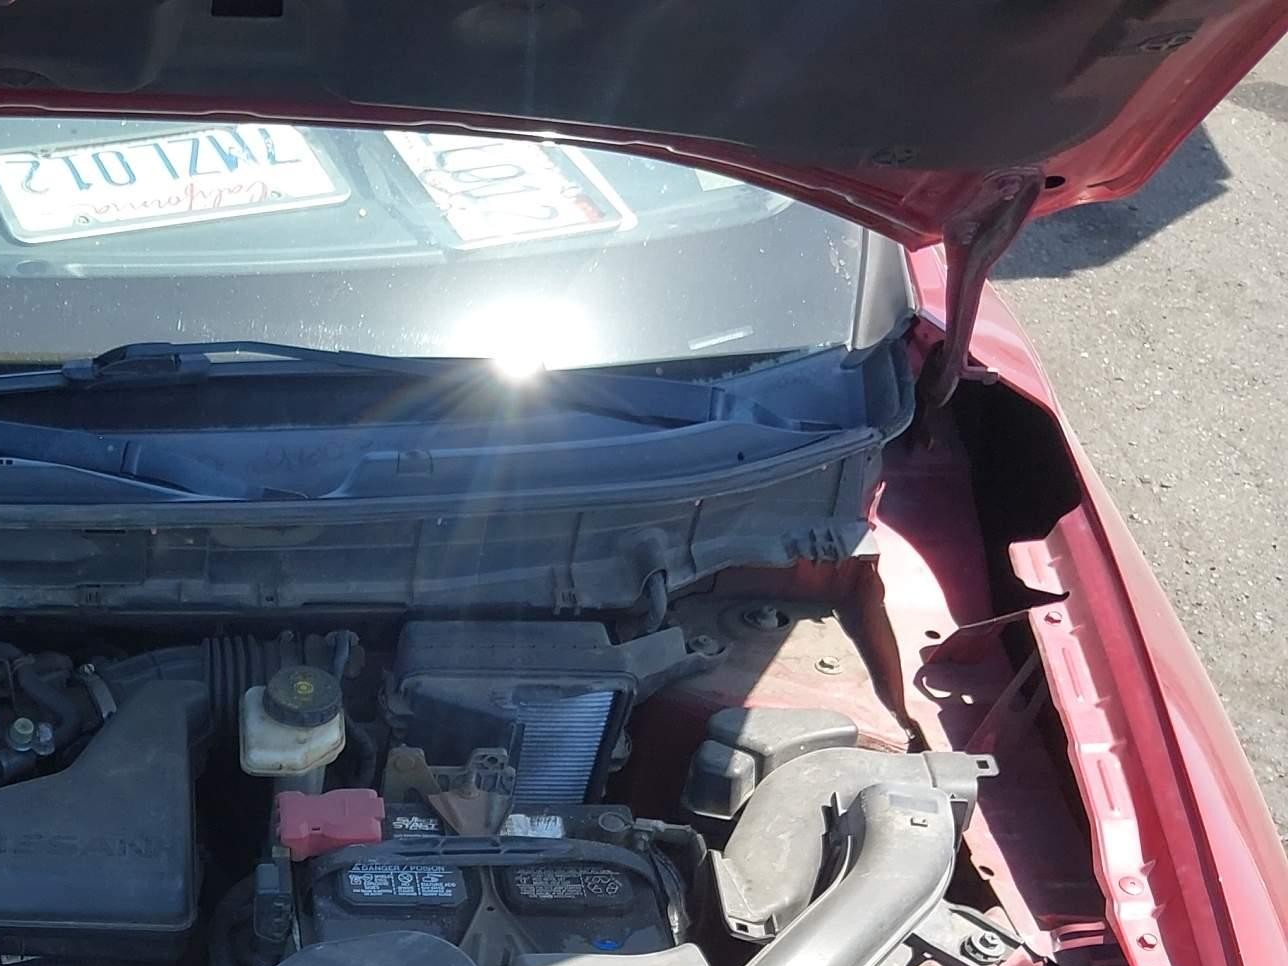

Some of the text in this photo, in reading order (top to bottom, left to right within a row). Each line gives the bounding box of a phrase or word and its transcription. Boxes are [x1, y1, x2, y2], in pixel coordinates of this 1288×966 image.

[5, 126, 302, 195] 7MZL012
[82, 181, 272, 216] California
[361, 864, 401, 872] DANGER
[409, 865, 446, 873] POISON
